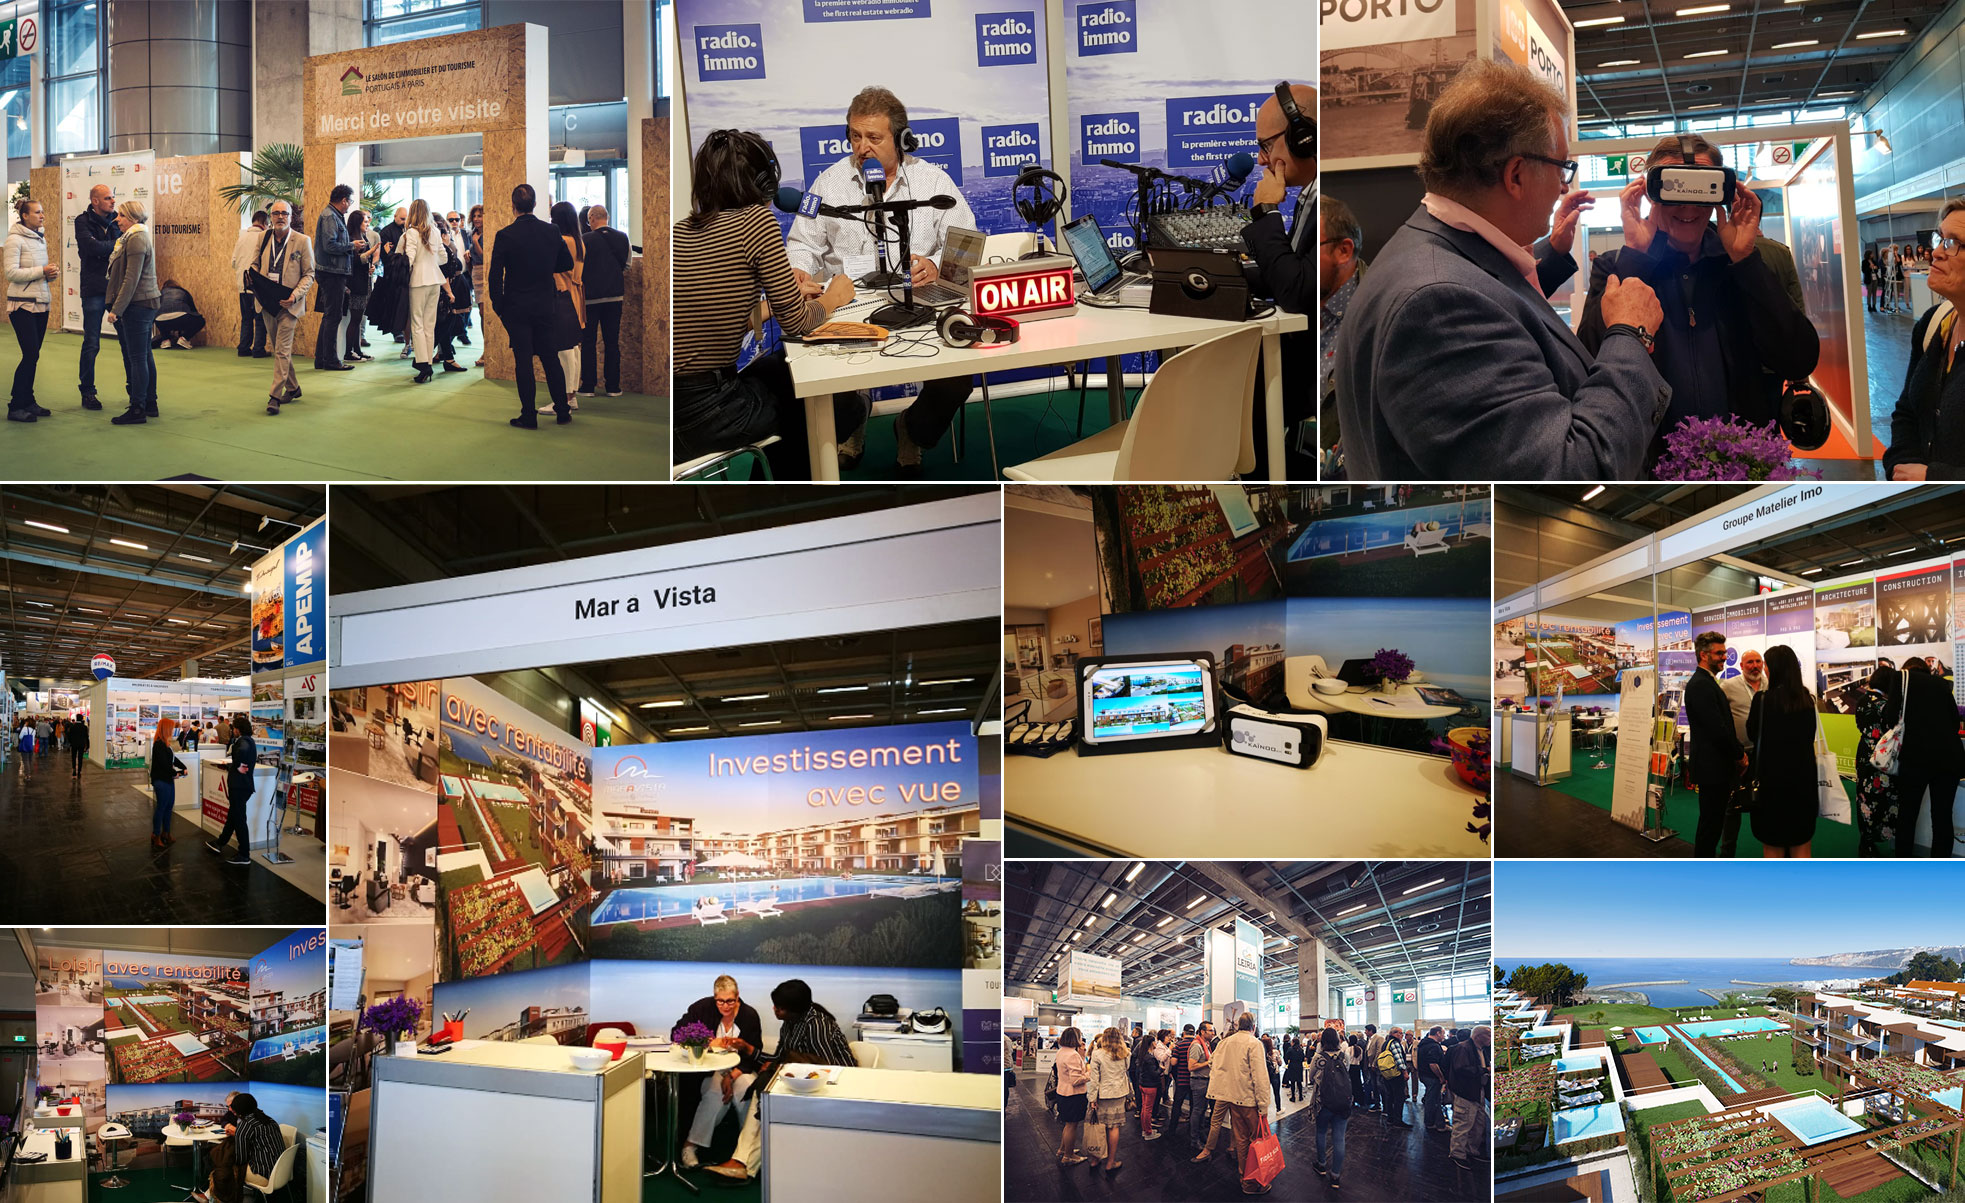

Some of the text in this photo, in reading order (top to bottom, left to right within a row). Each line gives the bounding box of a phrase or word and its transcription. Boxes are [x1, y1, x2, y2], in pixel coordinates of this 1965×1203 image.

[884, 7, 914, 15] webradio
[1081, 8, 1132, 27] radio.
[982, 18, 1032, 36] radio.
[700, 31, 757, 50] radio.
[1083, 30, 1131, 47] immo
[984, 41, 1032, 57] immo
[431, 66, 438, 74] ET
[438, 64, 447, 74] DU
[447, 60, 476, 72] TOURISME
[703, 54, 758, 71] immo
[407, 79, 425, 89] PARIS
[321, 98, 501, 133] Merci de votre visite
[565, 114, 578, 131] C
[1183, 102, 1260, 126] radio.i
[1086, 118, 1136, 137] radio.
[988, 130, 1037, 148] radio.
[1087, 140, 1135, 156] immo
[1182, 141, 1189, 149] la
[1190, 140, 1227, 150] première
[1191, 152, 1205, 161] the
[1205, 152, 1223, 161] first
[801, 194, 811, 213] radio.
[808, 197, 818, 215] immo
[162, 225, 171, 235] DU
[171, 224, 201, 235] TOURISME
[981, 275, 1069, 311] ON AIR
[1722, 486, 1823, 531] Groupe Matelier Imo
[1883, 575, 1942, 592] CONSTRUCTION
[296, 542, 313, 655] APEMIP
[575, 598, 619, 620] Mar
[653, 585, 716, 610] Vista
[1821, 587, 1868, 601] ARCHITECTURE
[1727, 606, 1759, 618] IMMOBILIERS
[1637, 614, 1689, 632] Invesssement
[446, 694, 499, 739] avec
[505, 722, 587, 779] rentabilité
[708, 738, 962, 778] Investissement
[807, 781, 961, 807] avec vue
[48, 956, 102, 974] Loisir
[107, 963, 150, 976] avec
[155, 961, 242, 981] rentabilité
[1237, 957, 1257, 971] LEIRIA
